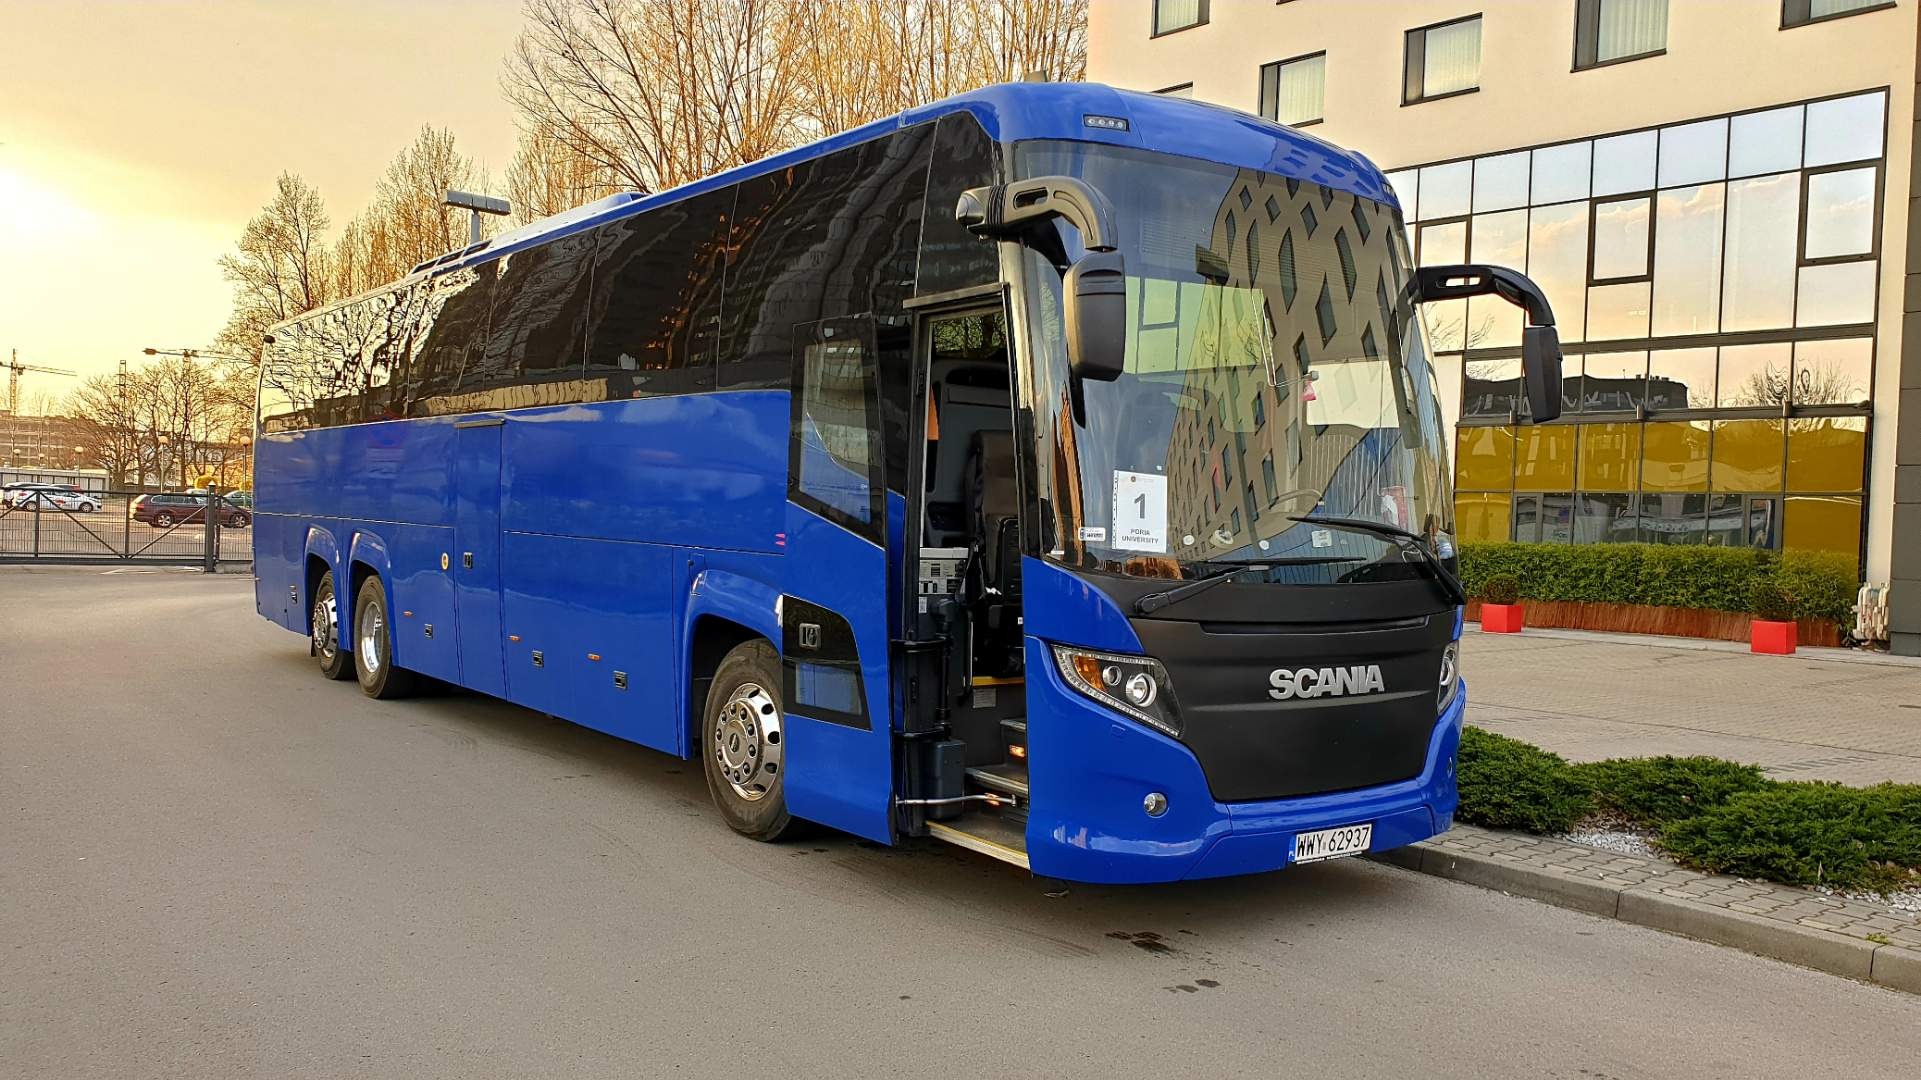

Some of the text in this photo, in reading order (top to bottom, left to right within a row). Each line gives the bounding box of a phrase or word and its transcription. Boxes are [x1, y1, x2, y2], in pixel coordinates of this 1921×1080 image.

[1134, 493, 1146, 519] 1
[1121, 535, 1159, 544] UNIVERSITY
[1268, 664, 1385, 700] SCANIA
[1297, 833, 1324, 857] WWY
[1328, 826, 1370, 852] 62937
